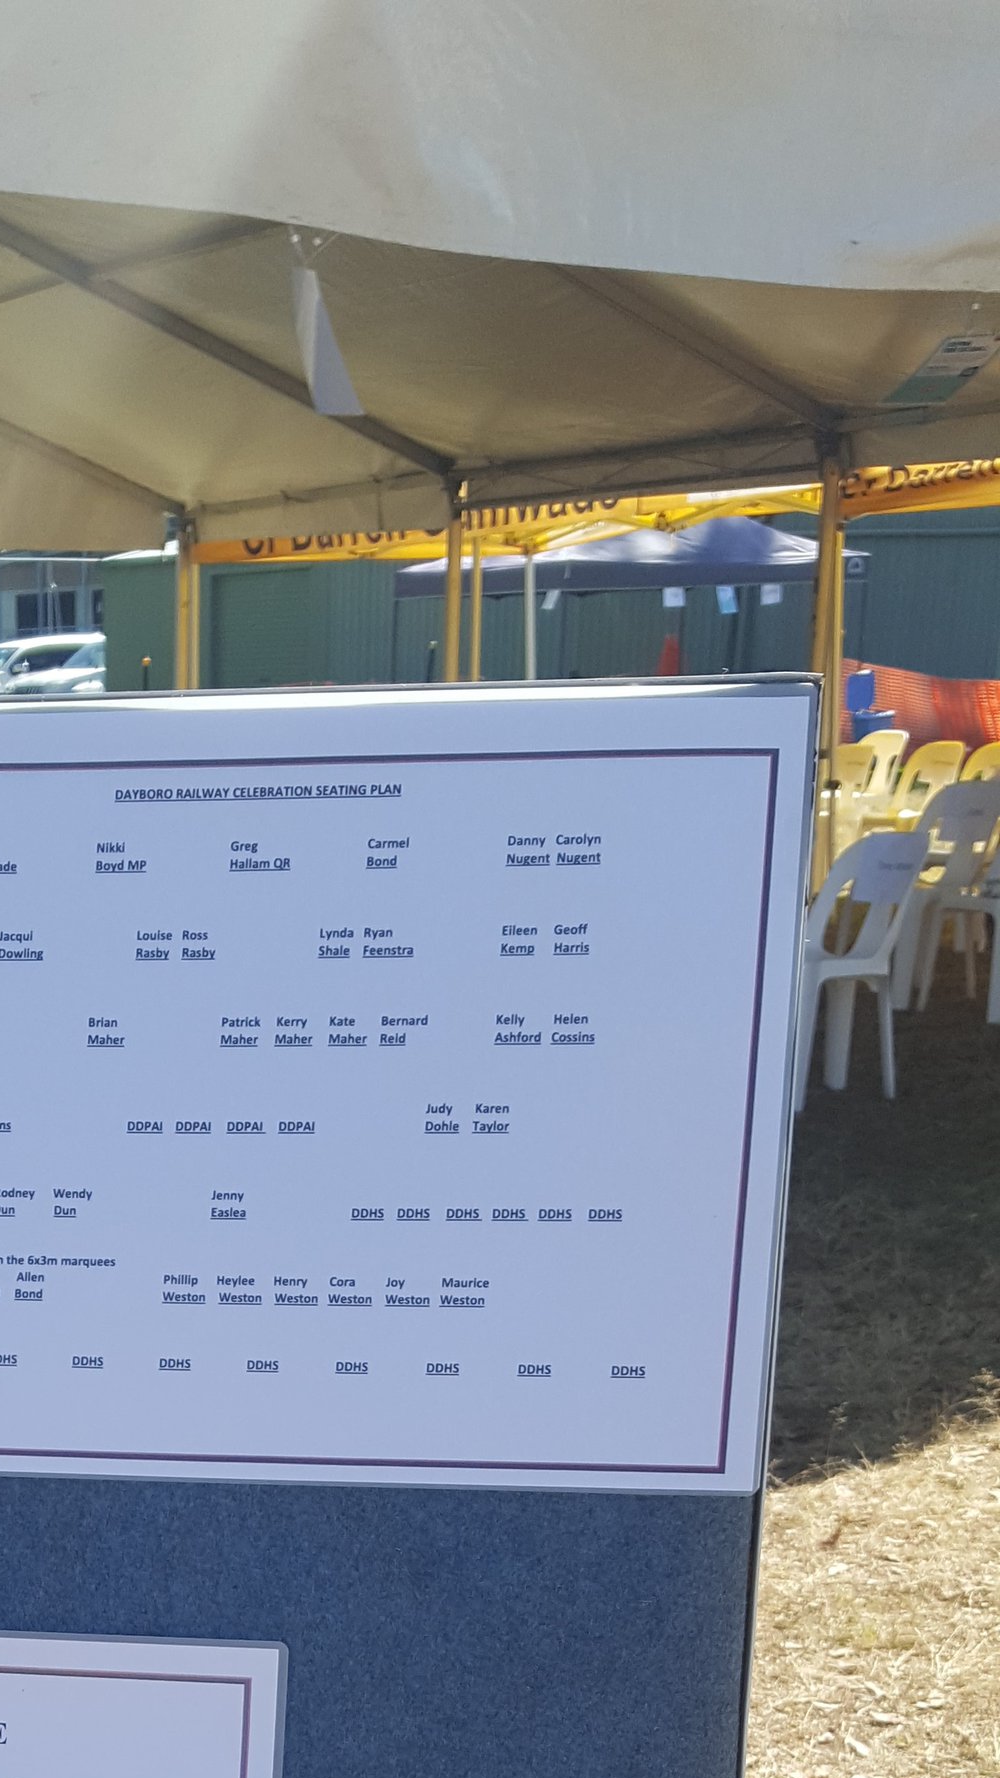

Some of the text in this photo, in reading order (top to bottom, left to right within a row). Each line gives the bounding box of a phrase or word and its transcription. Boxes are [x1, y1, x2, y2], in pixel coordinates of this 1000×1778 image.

[115, 783, 402, 803] DAYBORO RAILWAY CELEBRATION SEATING PLAN
[97, 842, 125, 853] Nikki
[231, 841, 258, 853] Greg
[368, 837, 409, 849] Carmel
[508, 836, 545, 847] Danny
[556, 834, 601, 846] Carolyn
[96, 859, 124, 874] Boyd
[127, 859, 146, 874] MP
[230, 856, 271, 872] Hallam
[273, 856, 291, 872] QR
[366, 855, 397, 869] Bond
[506, 854, 550, 866] Nugent
[556, 853, 601, 865] Nugent
[0, 931, 32, 943] Jacqui
[137, 930, 172, 940] Louise
[182, 930, 208, 940] Ross
[320, 928, 354, 940] Lynda
[364, 928, 393, 940] Ryan
[502, 925, 537, 936] Eileen
[554, 924, 588, 935] Geoff
[136, 947, 169, 961] Rasby
[181, 947, 215, 960] Rasby
[318, 945, 350, 959] Shale
[363, 945, 413, 958] Feenstra
[500, 944, 534, 956] Kemp
[553, 942, 589, 955] Harris
[7, 1255, 24, 1265] the
[28, 1256, 57, 1265] 6x3m
[61, 1258, 115, 1268] marquees
[72, 1356, 103, 1369] DDHS
[159, 1359, 190, 1371] DDHS
[247, 1360, 278, 1373] DDHS
[335, 1362, 368, 1374] DDHS
[426, 1363, 459, 1376] DDHS
[517, 1365, 551, 1377] DDHS
[611, 1366, 645, 1378] DDHS
